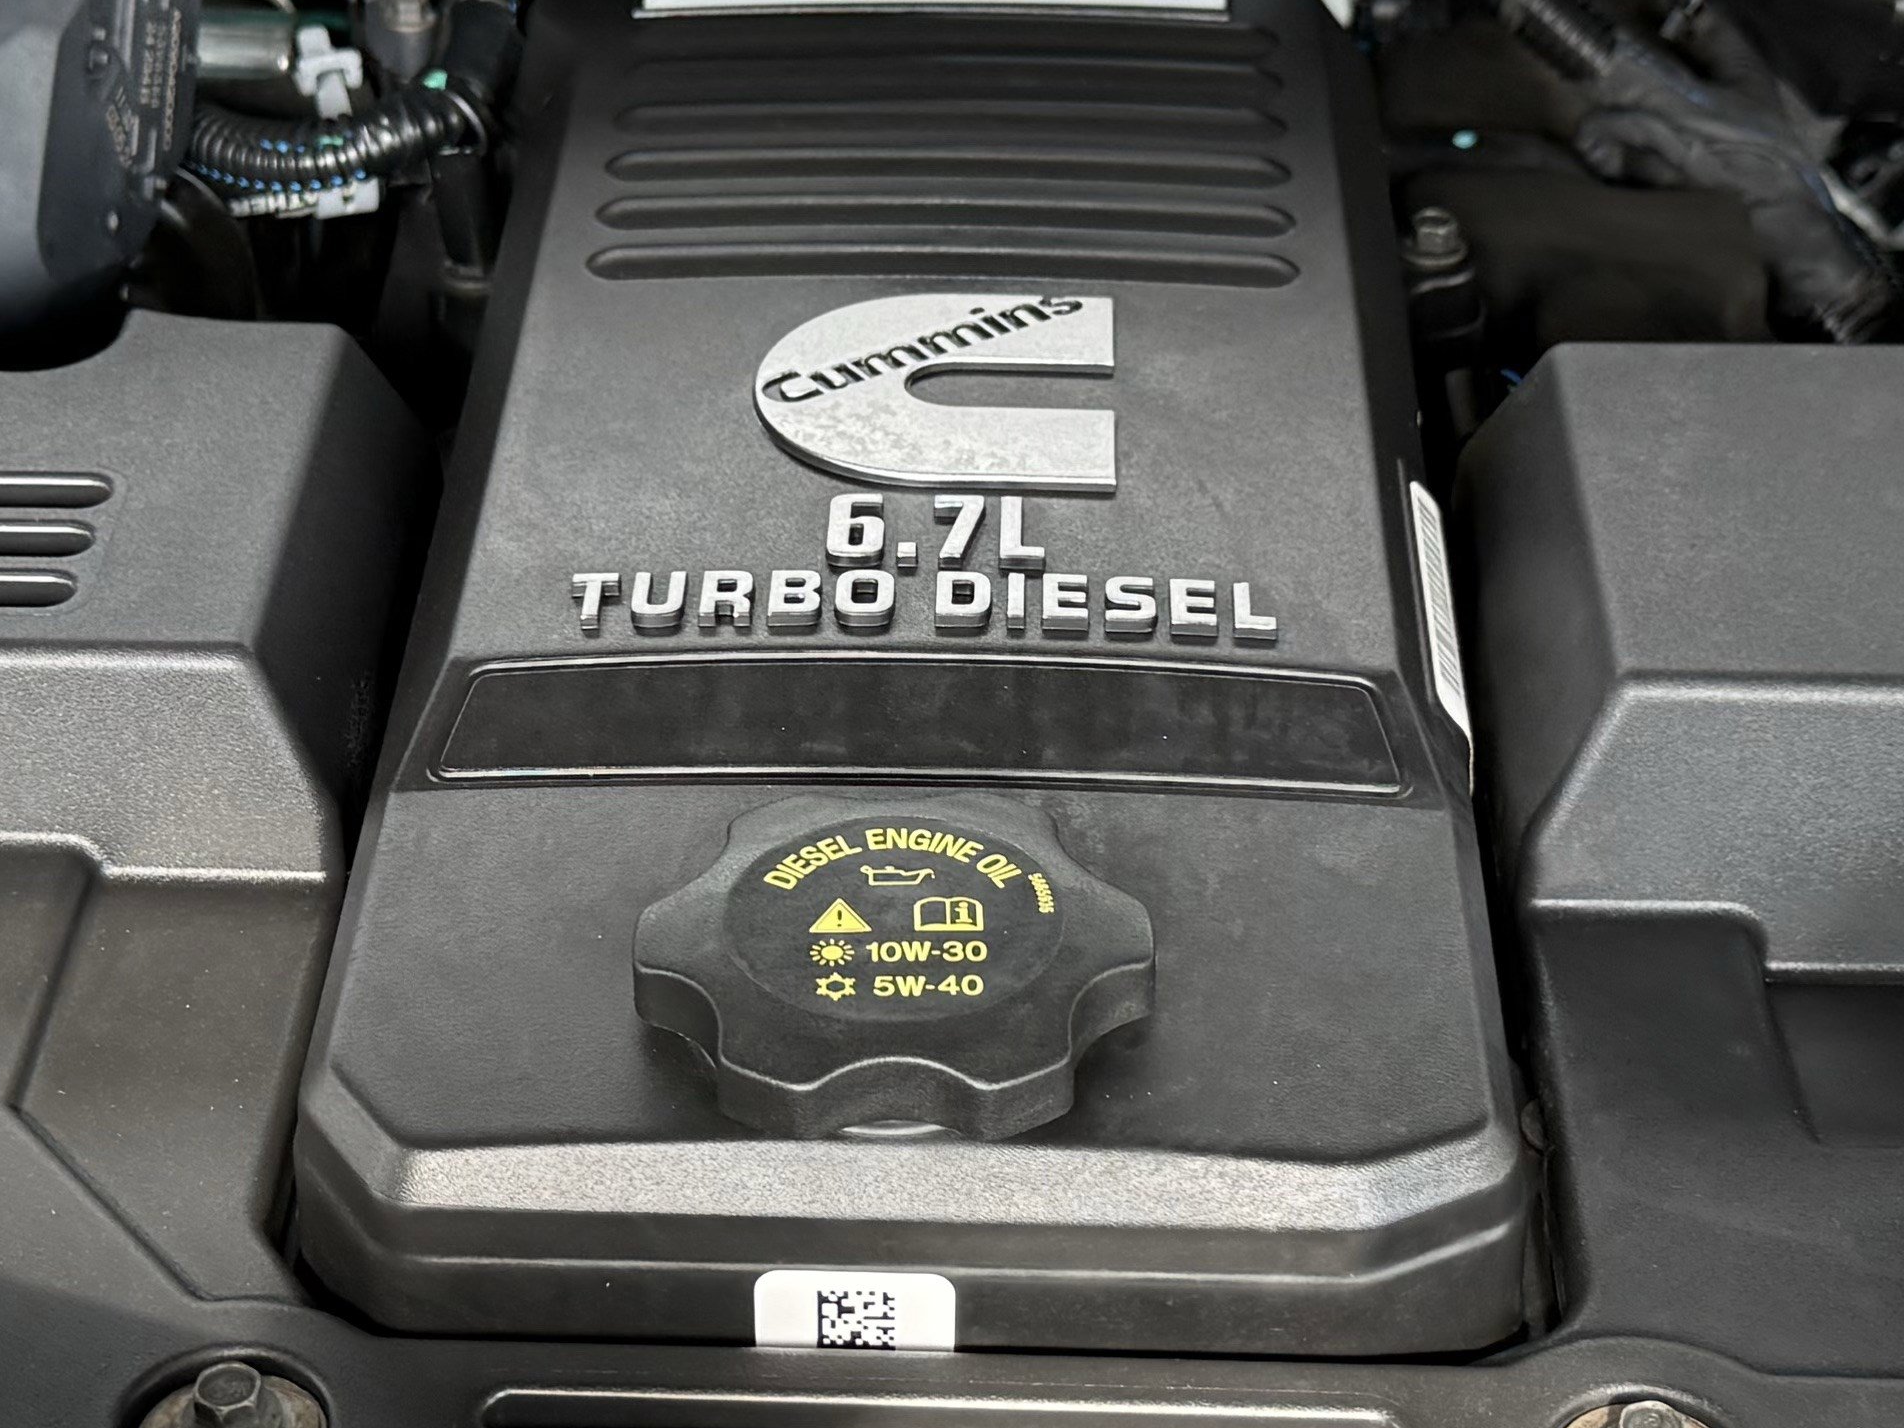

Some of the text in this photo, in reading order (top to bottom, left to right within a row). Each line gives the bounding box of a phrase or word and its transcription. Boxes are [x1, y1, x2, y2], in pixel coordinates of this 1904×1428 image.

[760, 293, 1084, 405] Cummins
[825, 492, 1046, 571] 6.7L
[571, 569, 1279, 641] TURBO DIESEL
[763, 827, 1023, 891] DIESEL ENGINE OIL
[864, 939, 989, 964] 10W-30
[871, 974, 986, 998] 5W-40
